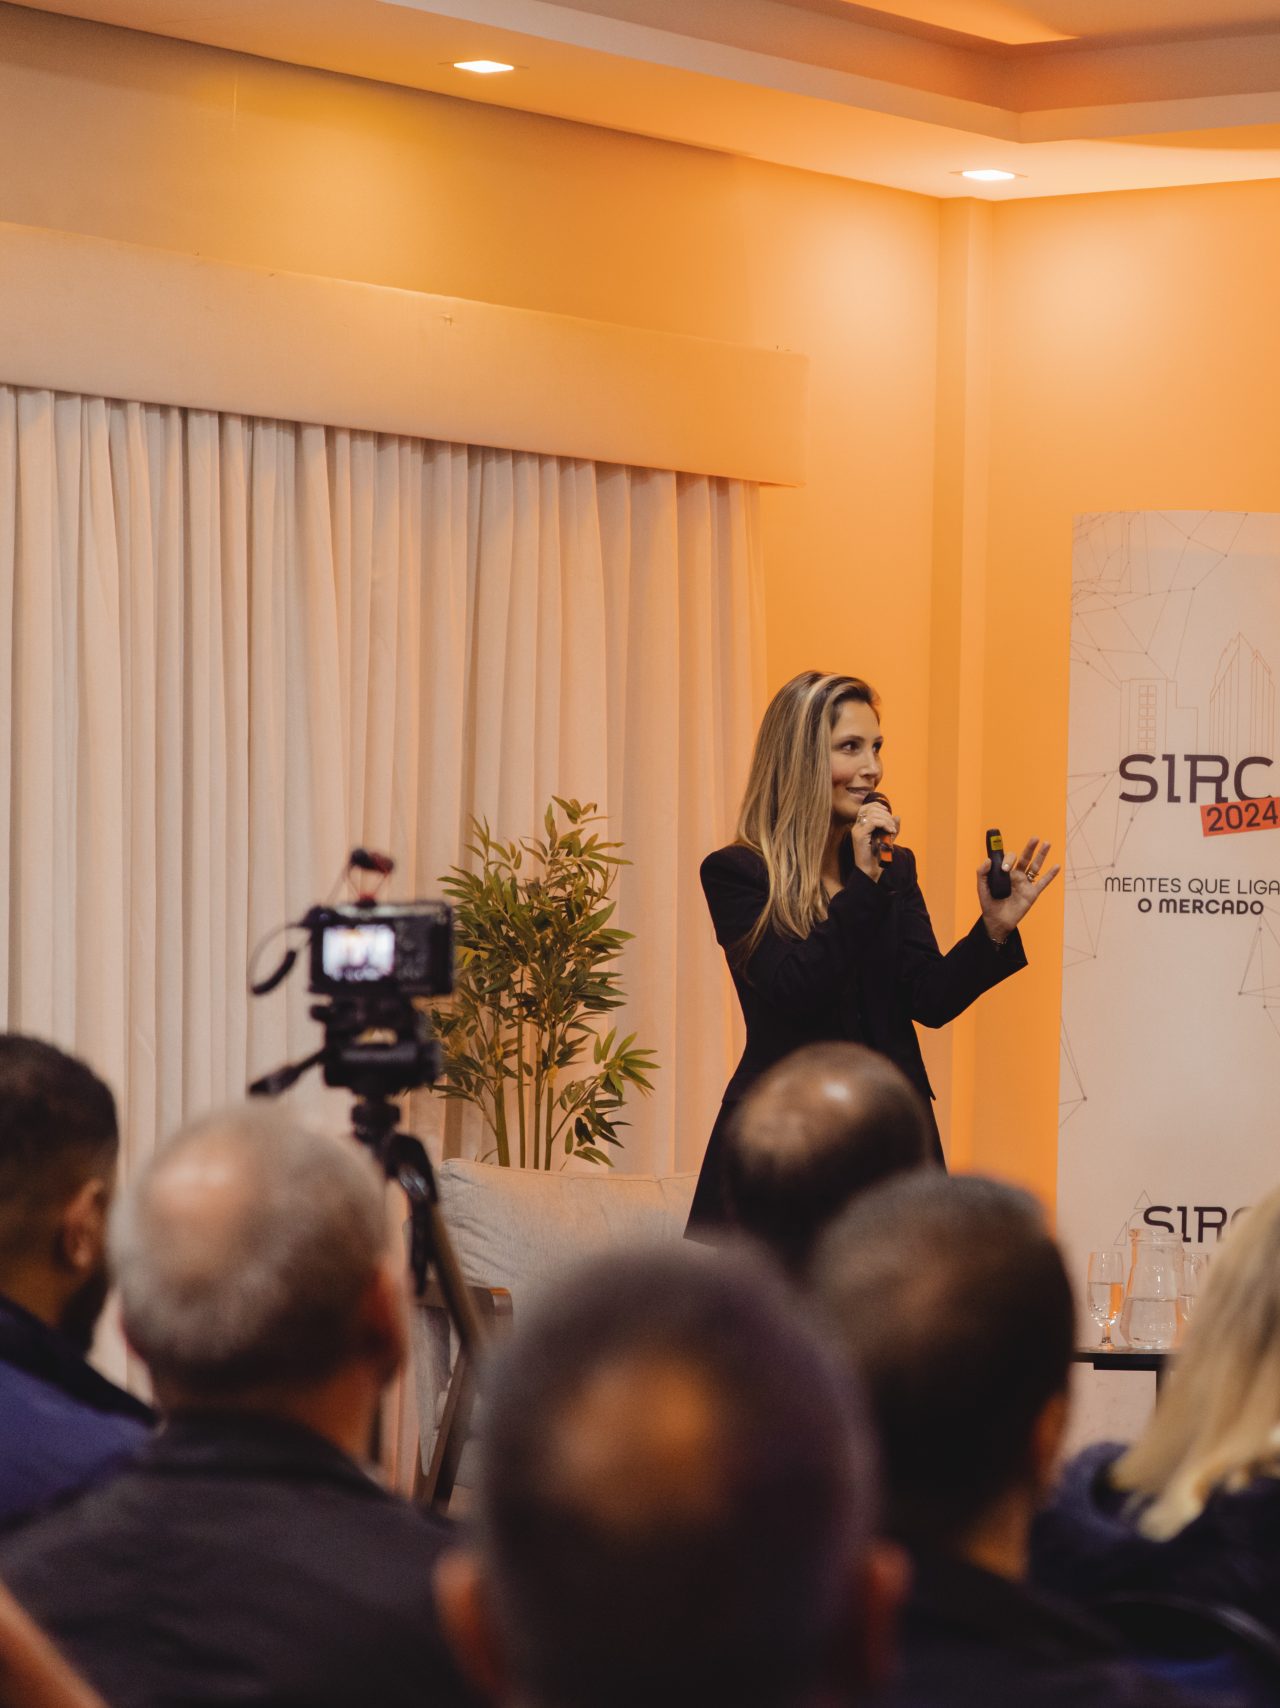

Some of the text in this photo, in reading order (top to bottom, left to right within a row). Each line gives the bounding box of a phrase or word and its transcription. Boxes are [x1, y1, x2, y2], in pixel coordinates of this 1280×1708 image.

[1118, 753, 1274, 804] SIRC
[1206, 800, 1279, 833] 2024
[1104, 876, 1181, 894] MENTES
[1188, 878, 1231, 896] QUE
[1137, 898, 1264, 915] O MERCADO
